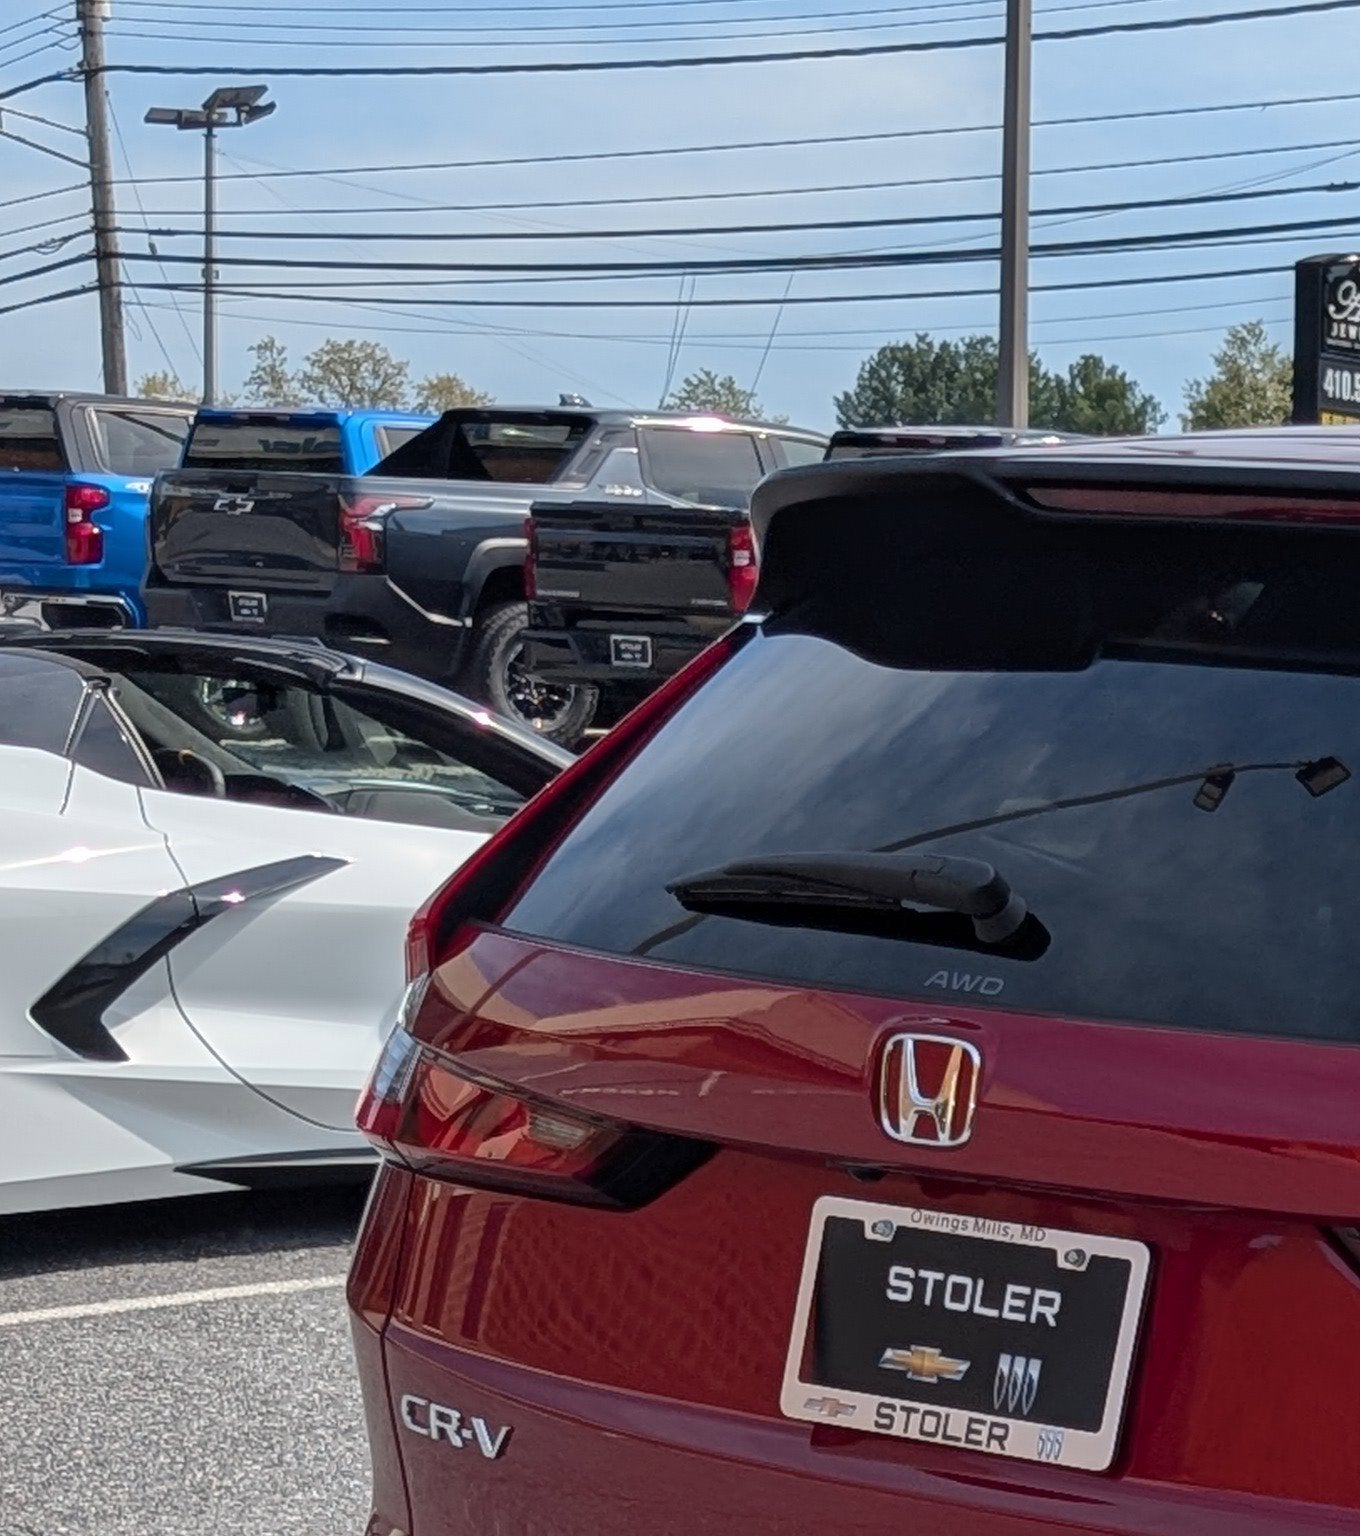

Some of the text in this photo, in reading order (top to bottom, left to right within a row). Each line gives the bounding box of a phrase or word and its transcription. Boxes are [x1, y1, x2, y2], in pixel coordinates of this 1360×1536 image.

[923, 970, 1005, 995] AWD
[910, 1208, 1047, 1243] Owings Mills, MD
[886, 1264, 1062, 1328] STOLER
[401, 1394, 511, 1459] CR-V
[873, 1401, 1010, 1452] STOLER
